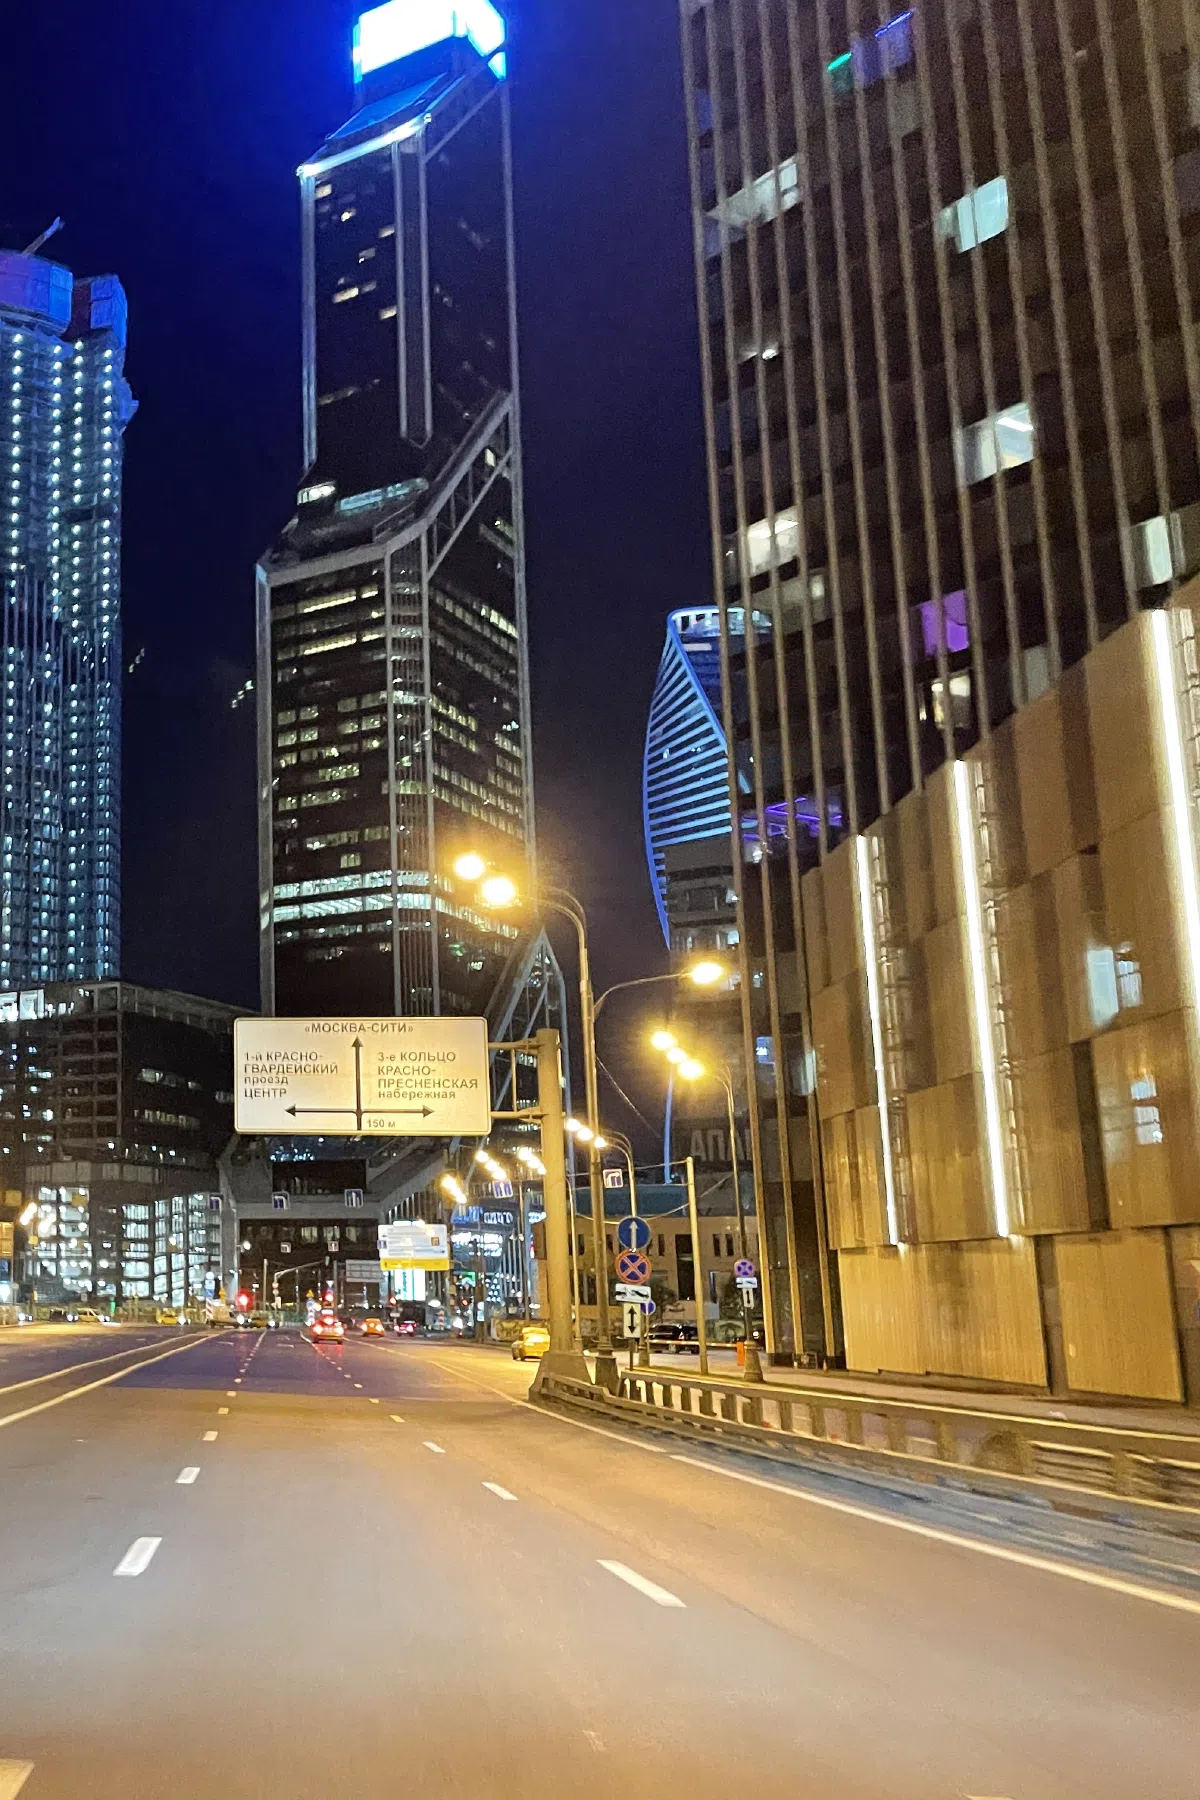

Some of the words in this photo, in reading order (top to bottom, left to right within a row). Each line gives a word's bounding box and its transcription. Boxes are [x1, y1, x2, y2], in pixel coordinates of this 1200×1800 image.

[304, 1022, 414, 1033] «МОСКВА-СИТИ»
[245, 1051, 262, 1061] 1-й
[266, 1051, 323, 1062] КРАСНО-
[377, 1052, 396, 1062] 3-е
[400, 1052, 456, 1063] КОЛЬЦО
[244, 1062, 338, 1074] ГВАРДЕЙСКИЙ
[377, 1065, 436, 1076] КРАСНО-
[244, 1076, 289, 1086] проезд
[377, 1078, 478, 1089] ПРЕСНЕНСКАЯ
[244, 1088, 287, 1099] ЦЕНТР
[378, 1089, 456, 1100] набережная
[367, 1119, 385, 1128] 150
